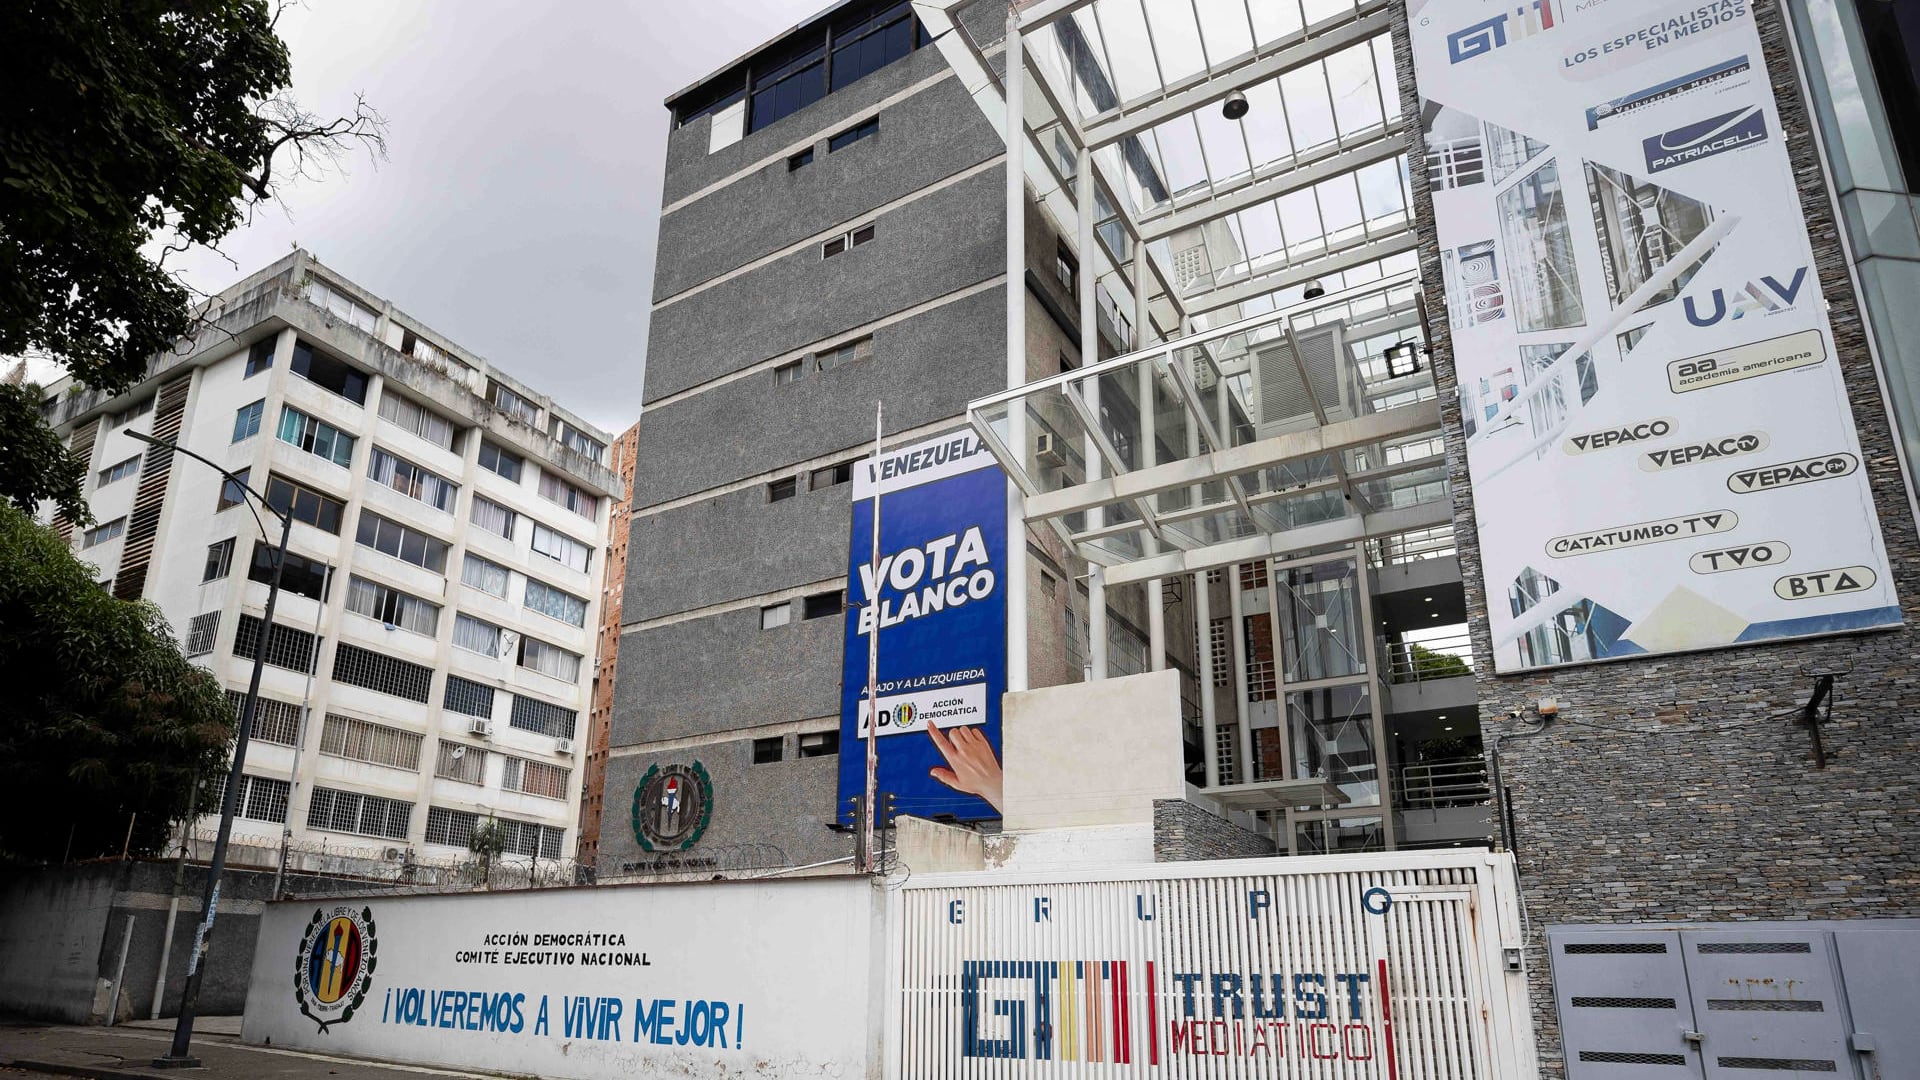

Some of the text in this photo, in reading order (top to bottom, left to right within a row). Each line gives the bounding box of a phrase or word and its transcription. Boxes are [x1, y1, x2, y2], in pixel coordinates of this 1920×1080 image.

[1645, 5, 1746, 50] EN MEDIOS
[1564, 48, 1598, 68] LOS
[1691, 66, 1747, 88] Makarem
[1652, 131, 1762, 169] PATRIACELL
[1683, 266, 1808, 327] UAV
[1678, 358, 1717, 377] aa
[1679, 366, 1740, 385] academia
[1743, 351, 1812, 371] americana
[1570, 420, 1670, 450] VEPACO
[869, 437, 990, 483] VENEZUELA
[1554, 514, 1722, 552] CATATUMBO TV
[859, 526, 989, 600] VOTA
[1702, 546, 1772, 570] TVO
[1789, 572, 1861, 597] BTA
[858, 569, 994, 635] BLANCO
[861, 668, 985, 696] AAJO Y A LA IZQUIERDA
[919, 705, 978, 720] DEMOCRÁTICA
[932, 698, 963, 709] ACCIÓN
[484, 930, 626, 946] ACCIÓN DEMOCRÁTICA
[456, 949, 651, 966] COMITÉ EJECUTIVO NACIONAL
[1174, 973, 1369, 1019] TRUST
[535, 995, 549, 1036] A
[1171, 1020, 1372, 1061] MEDIATICO
